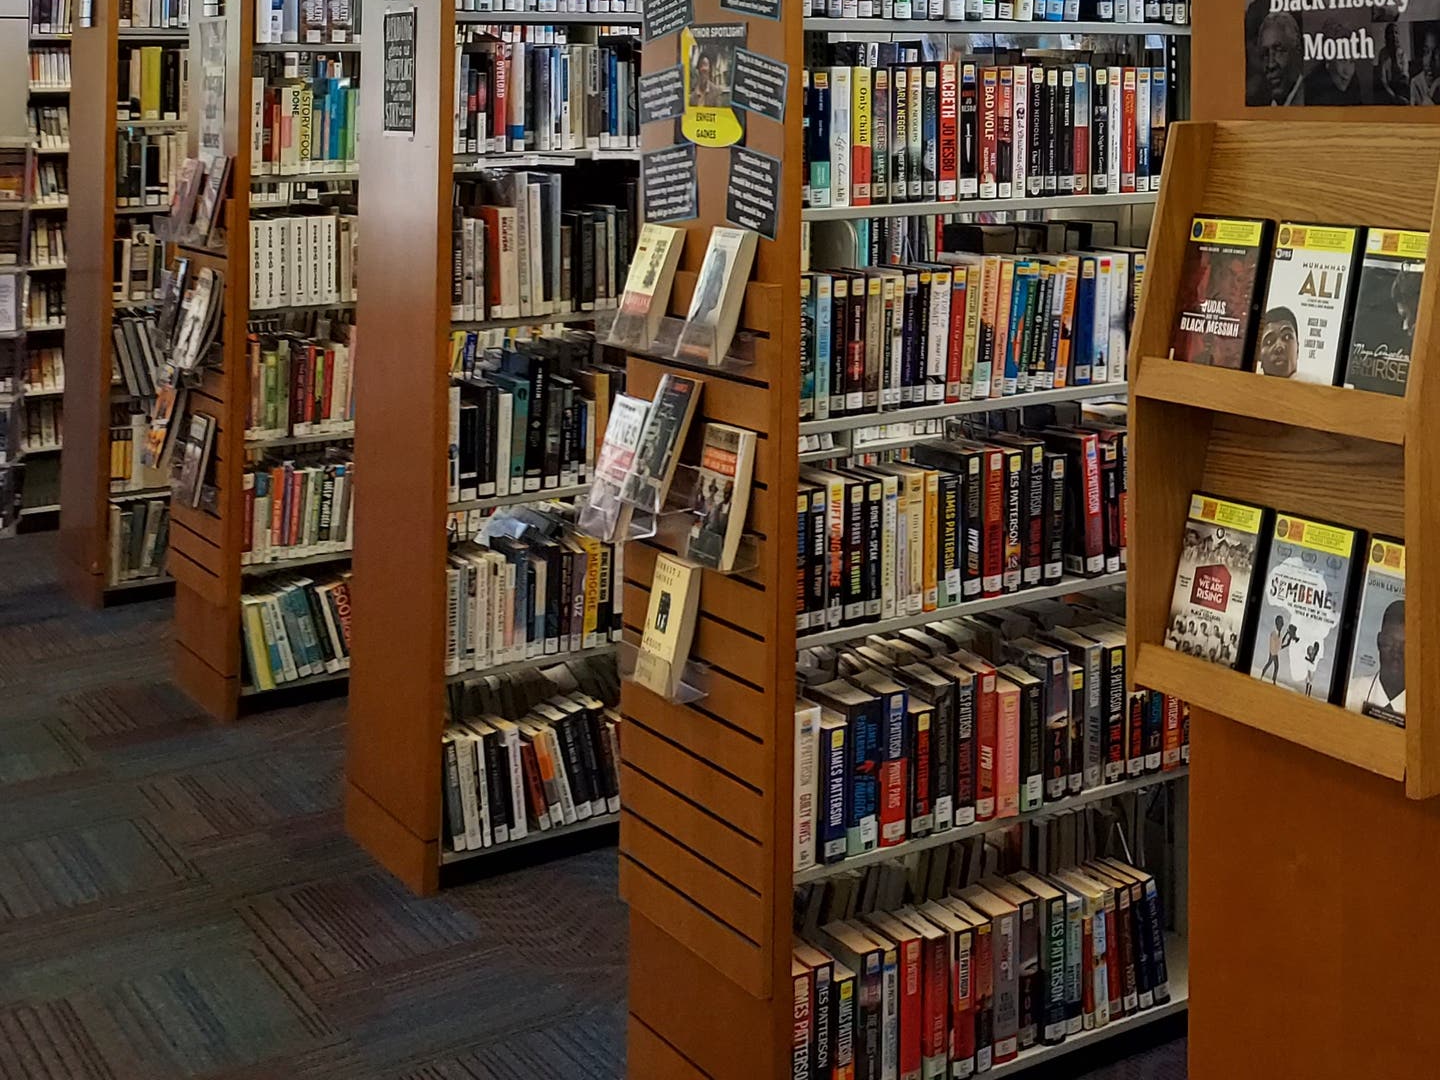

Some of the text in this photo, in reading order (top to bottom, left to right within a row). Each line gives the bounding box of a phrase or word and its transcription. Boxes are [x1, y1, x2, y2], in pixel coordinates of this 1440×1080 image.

[711, 26, 744, 38] SPOTLIGHT
[1303, 28, 1375, 61] Month
[496, 61, 504, 98] OVERLOAD
[696, 112, 716, 123] ERNEST
[858, 87, 867, 143] Only Child
[942, 73, 956, 136] ACBETH JO
[984, 87, 995, 141] BAD WOLF
[1303, 262, 1346, 272] MUHAMMAD
[1298, 270, 1343, 300] ALI
[1200, 300, 1227, 315] JUDAS
[1180, 317, 1239, 338] BLACK MESSIAH
[1376, 360, 1408, 383] RISE
[1030, 477, 1042, 516] PATTERSON
[1089, 481, 1100, 515] PATTERSON
[870, 505, 879, 561] BONES SPEAK
[944, 491, 956, 572] JAMES PATTERSON
[1009, 489, 1019, 546] PATTERSON
[815, 534, 823, 556] PARKS
[333, 586, 351, 615] 500
[1196, 588, 1222, 604] RISING
[1199, 578, 1210, 591] WE
[1210, 581, 1224, 593] ARE
[1368, 578, 1405, 594] JOHN LEWI
[573, 594, 583, 617] CUZ
[1110, 678, 1124, 716] PATTERSON
[959, 706, 972, 739] PATTERSON
[889, 722, 902, 759] PATTERSON
[830, 748, 843, 827] JAMES PATTERSON
[1051, 942, 1064, 1002] PATTERSON
[794, 1020, 809, 1080] PATTERSO
[818, 1007, 829, 1069] PATTERSON
